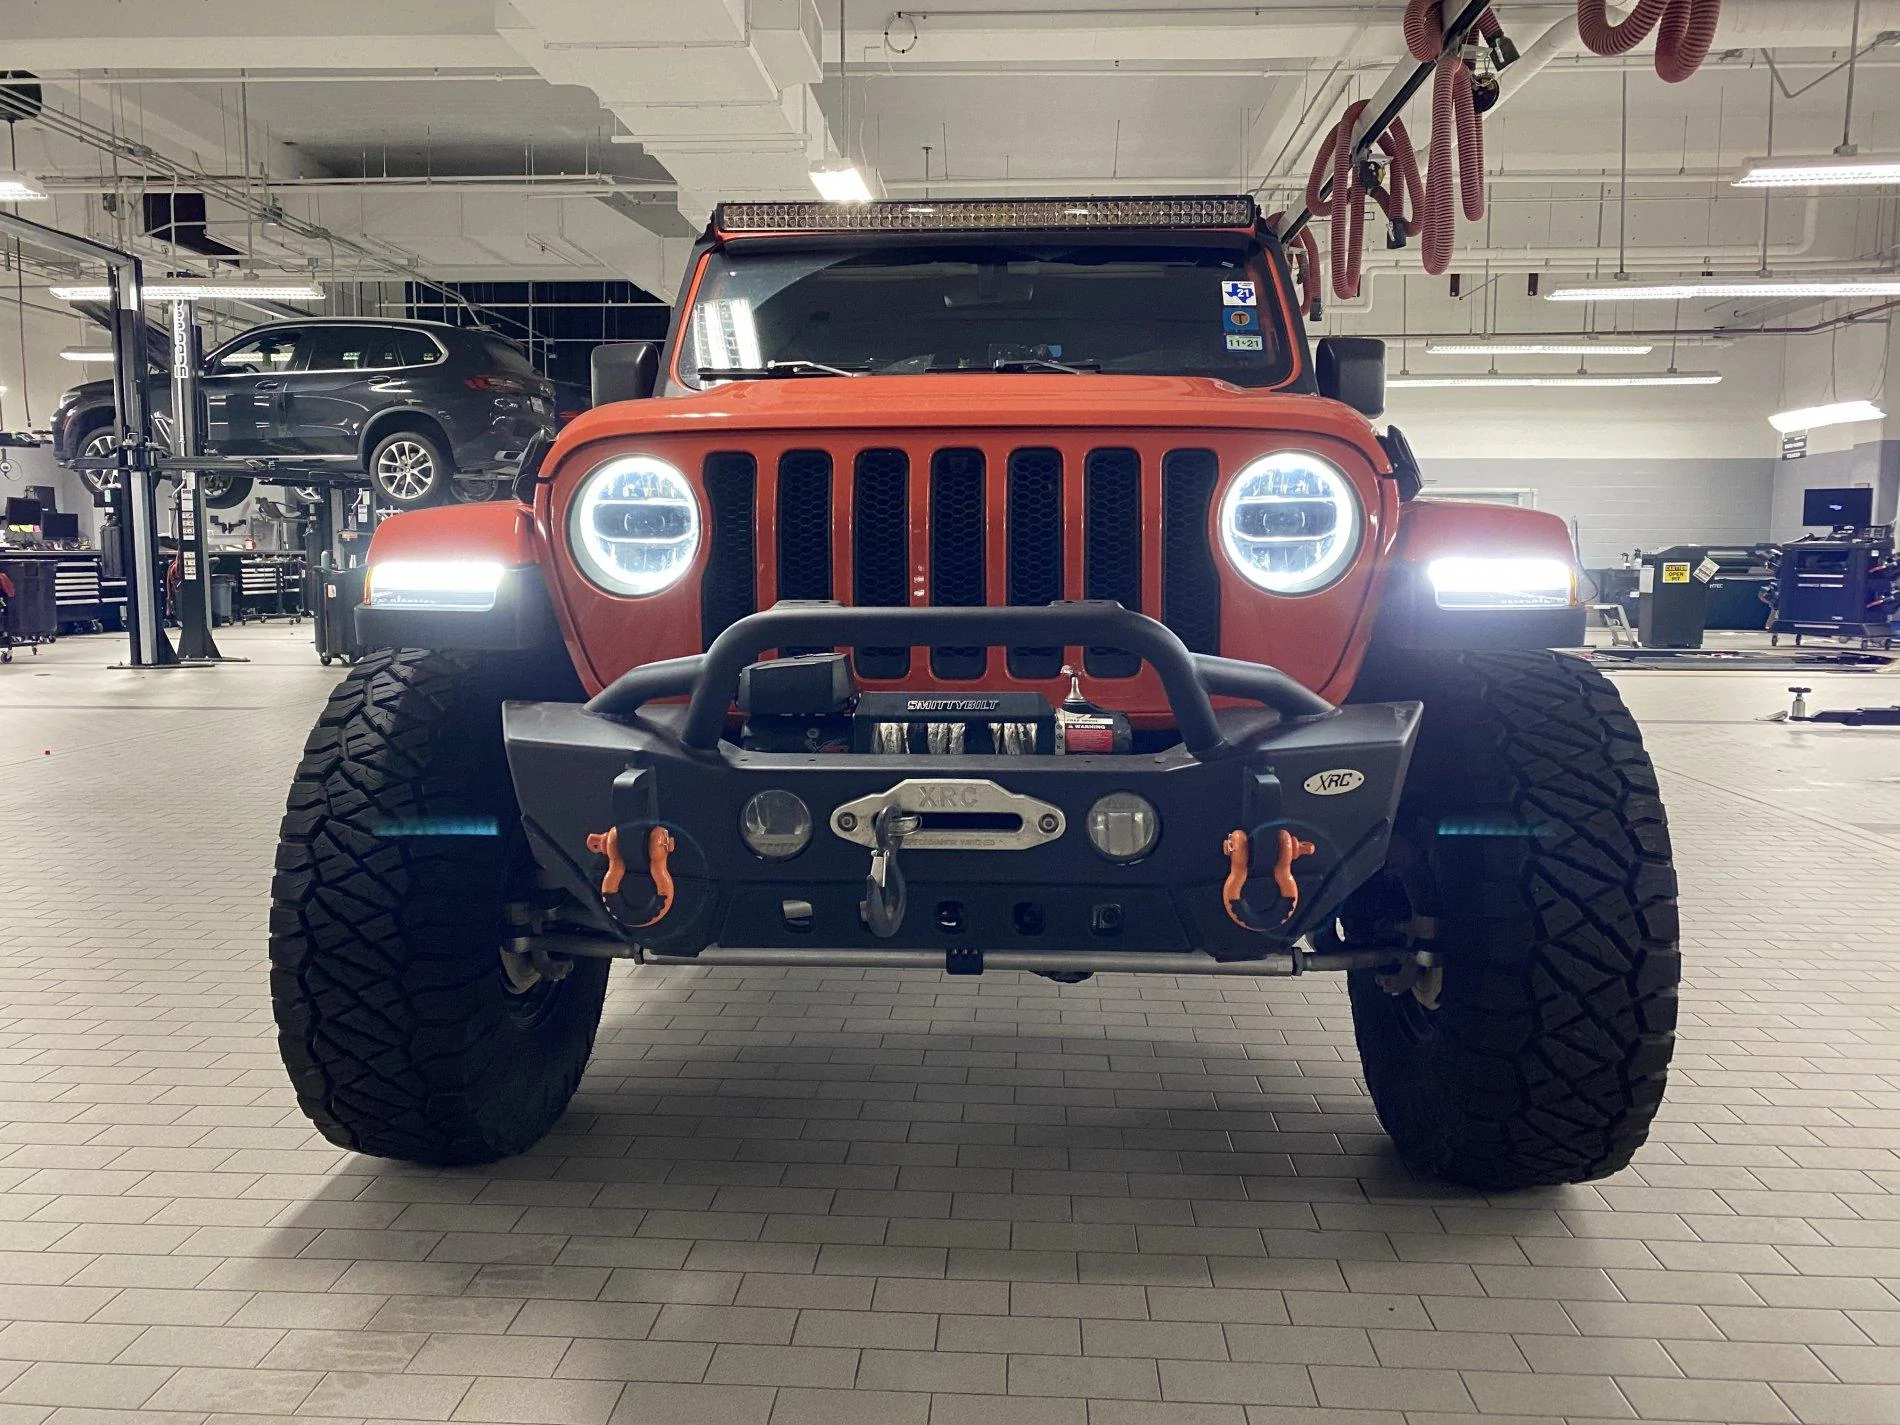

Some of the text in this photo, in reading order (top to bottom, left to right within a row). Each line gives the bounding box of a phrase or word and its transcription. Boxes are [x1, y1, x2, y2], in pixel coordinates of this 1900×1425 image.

[1236, 288, 1250, 298] 21
[906, 700, 999, 711] SMITTYBILT
[1315, 773, 1353, 792] XRC
[918, 786, 979, 808] XRC
